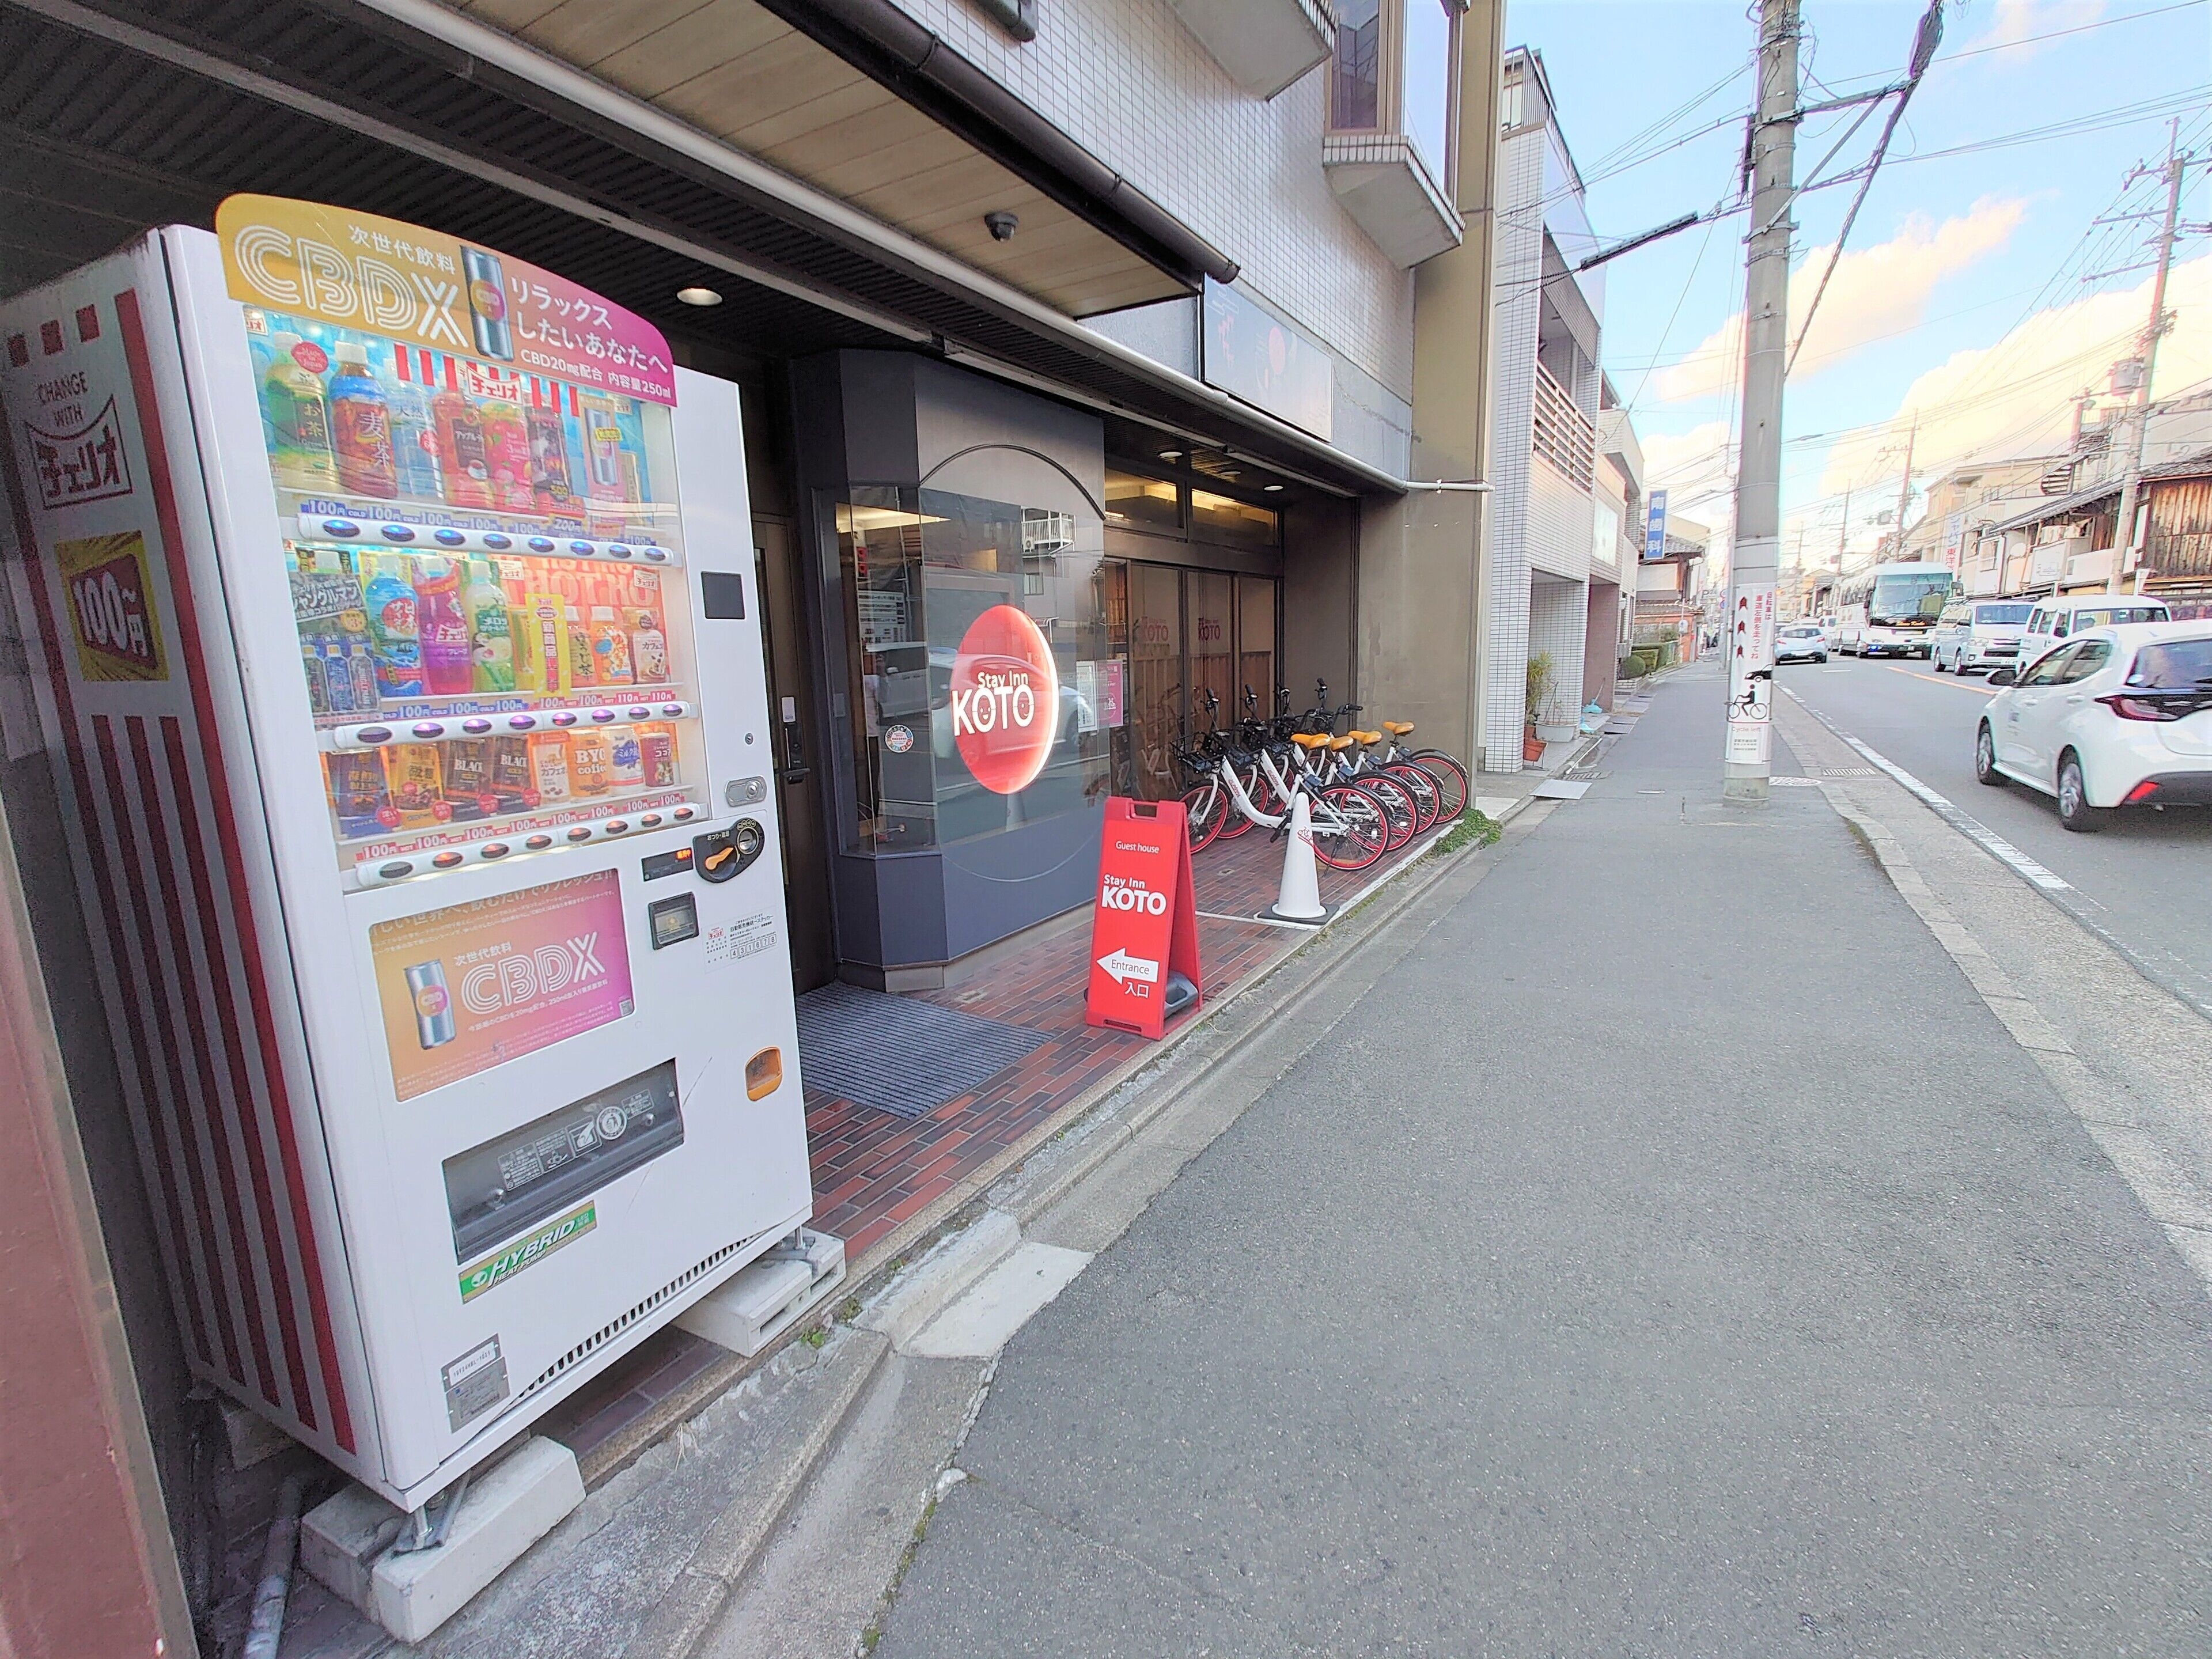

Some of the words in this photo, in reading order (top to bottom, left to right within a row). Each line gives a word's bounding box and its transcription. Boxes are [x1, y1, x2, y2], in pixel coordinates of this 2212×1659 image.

[348, 225, 456, 275] 次世代飲料
[234, 225, 469, 349] CBDX
[512, 276, 612, 330] リラックス
[516, 319, 669, 374] したいあなたへ
[37, 372, 89, 405] CHANGE
[471, 374, 518, 401] チェリオ
[55, 405, 84, 427] WITH
[359, 411, 390, 468] 麦茶
[36, 423, 120, 499] チェリオ
[977, 671, 1006, 689] Stay
[1009, 669, 1029, 687] Inn
[952, 684, 1035, 737] KOTO
[1115, 840, 1137, 853] Guest
[1137, 842, 1160, 854] house
[1104, 874, 1127, 889] Stay
[1129, 876, 1145, 889] Inn
[1101, 885, 1167, 916] KOTO
[454, 941, 513, 967] 次世代飲料
[1111, 958, 1150, 976] Entrance
[460, 931, 606, 1016] CBDX
[1124, 982, 1150, 999] 入口
[487, 1219, 576, 1289] HYBRID
[495, 1264, 520, 1284] HEAT
[520, 1249, 547, 1270] PUMP
